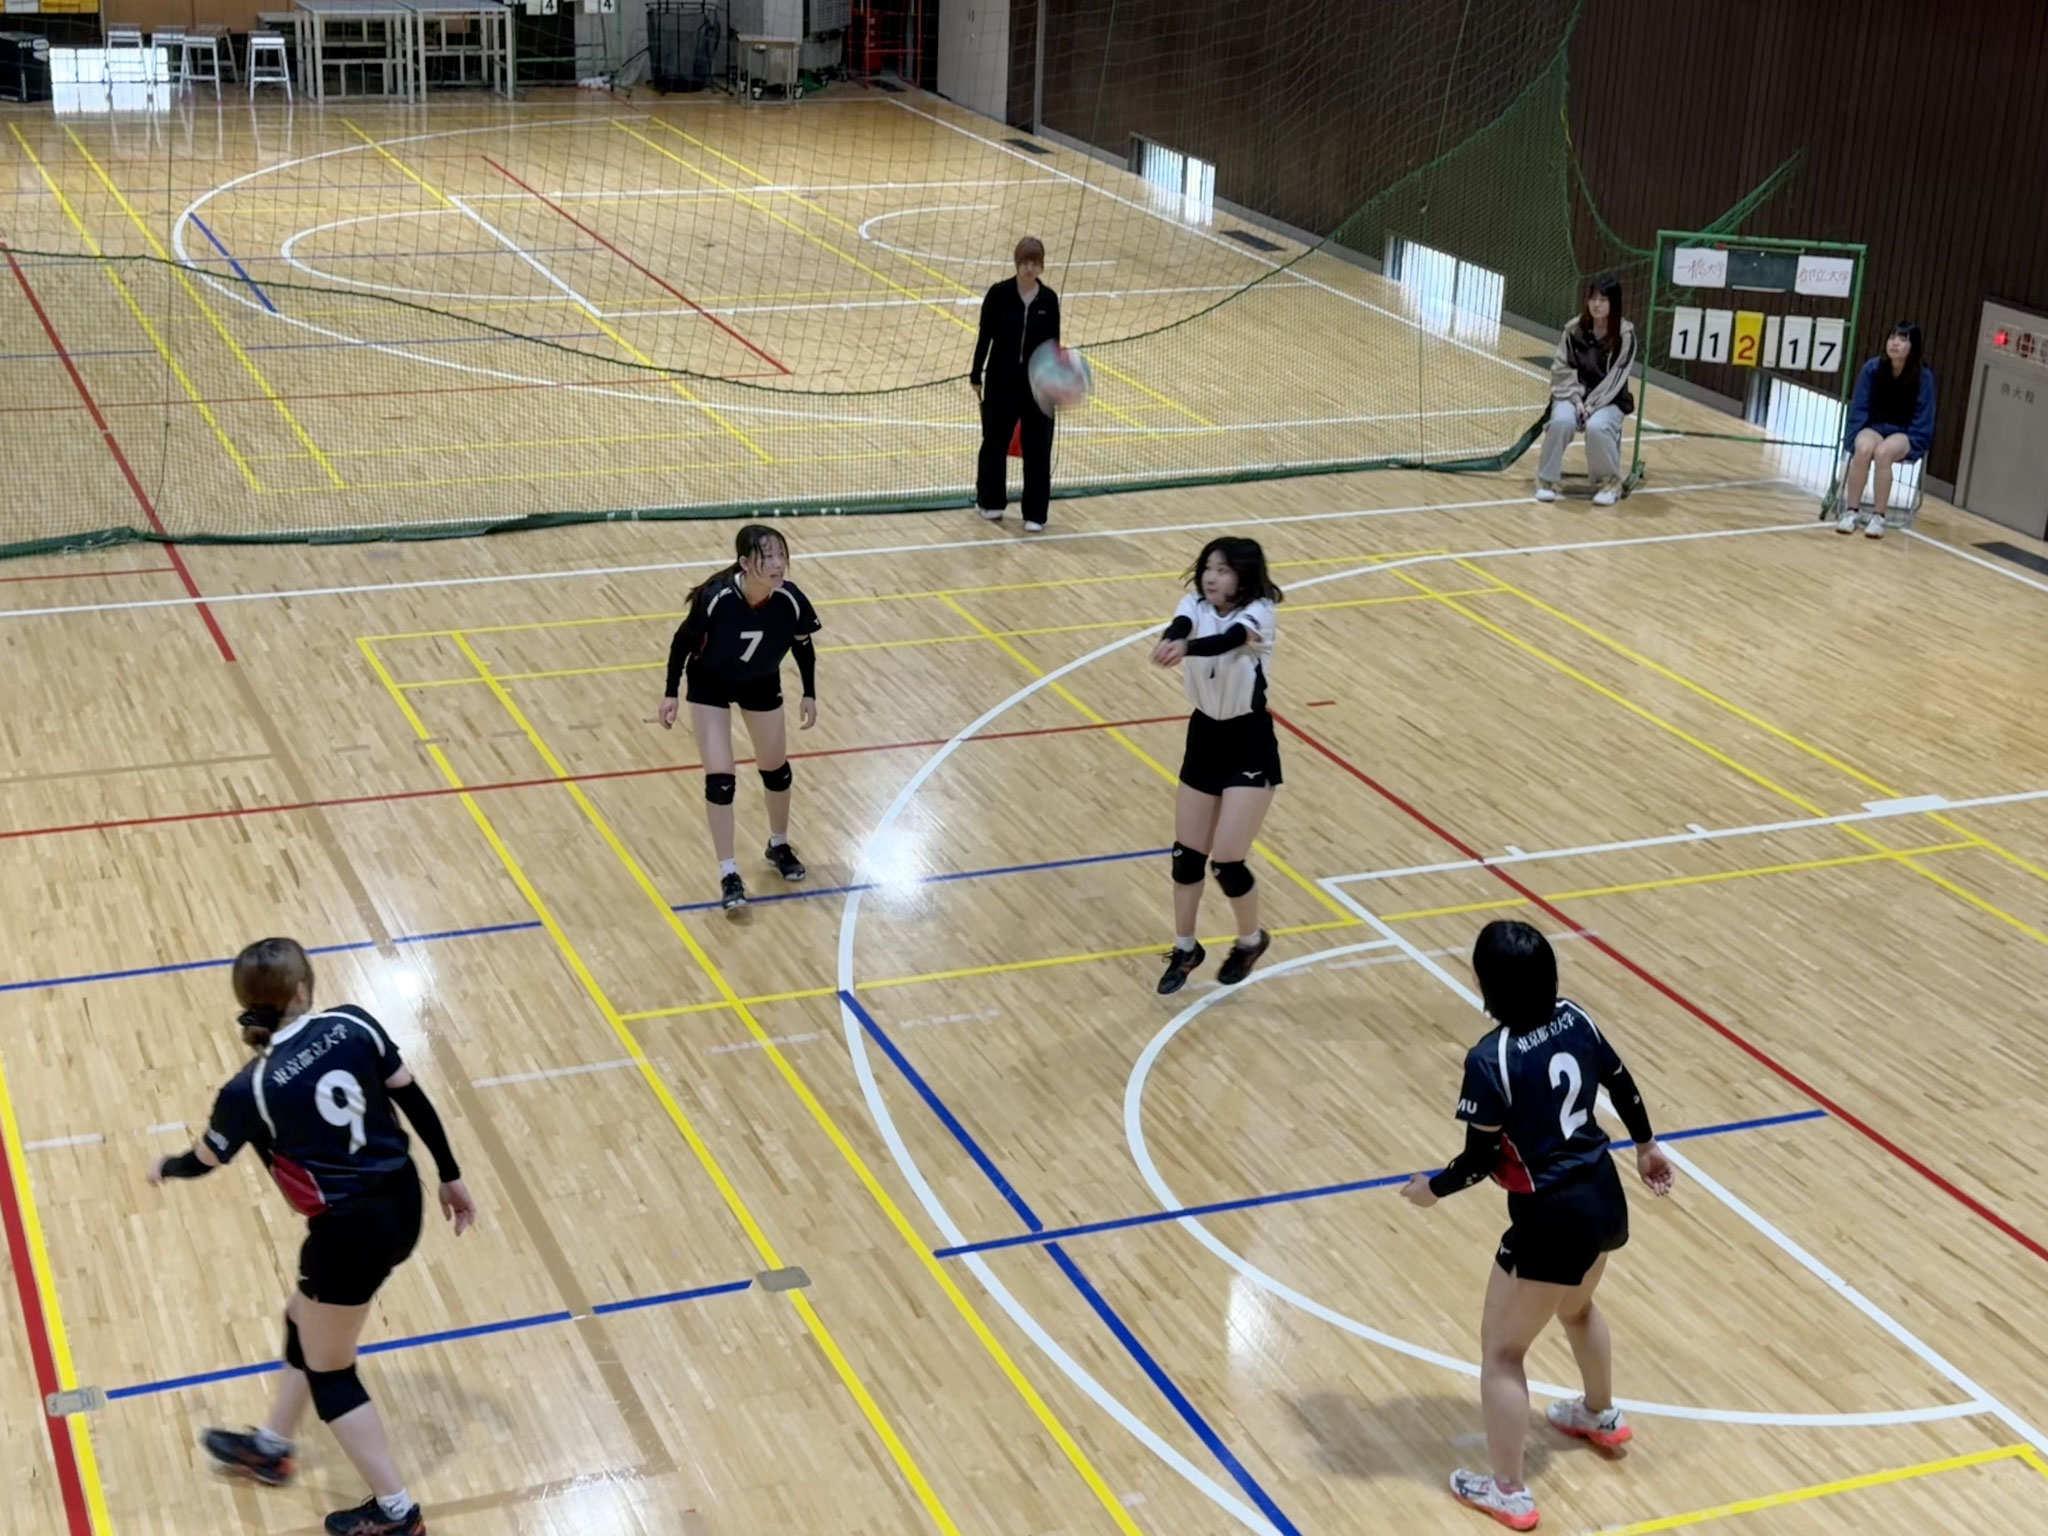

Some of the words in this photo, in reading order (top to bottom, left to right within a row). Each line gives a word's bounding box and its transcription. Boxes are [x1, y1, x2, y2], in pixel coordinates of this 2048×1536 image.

[1738, 335, 1756, 361] 2
[739, 630, 764, 663] 7
[315, 1069, 367, 1156] 9
[1548, 1051, 1588, 1141] 2
